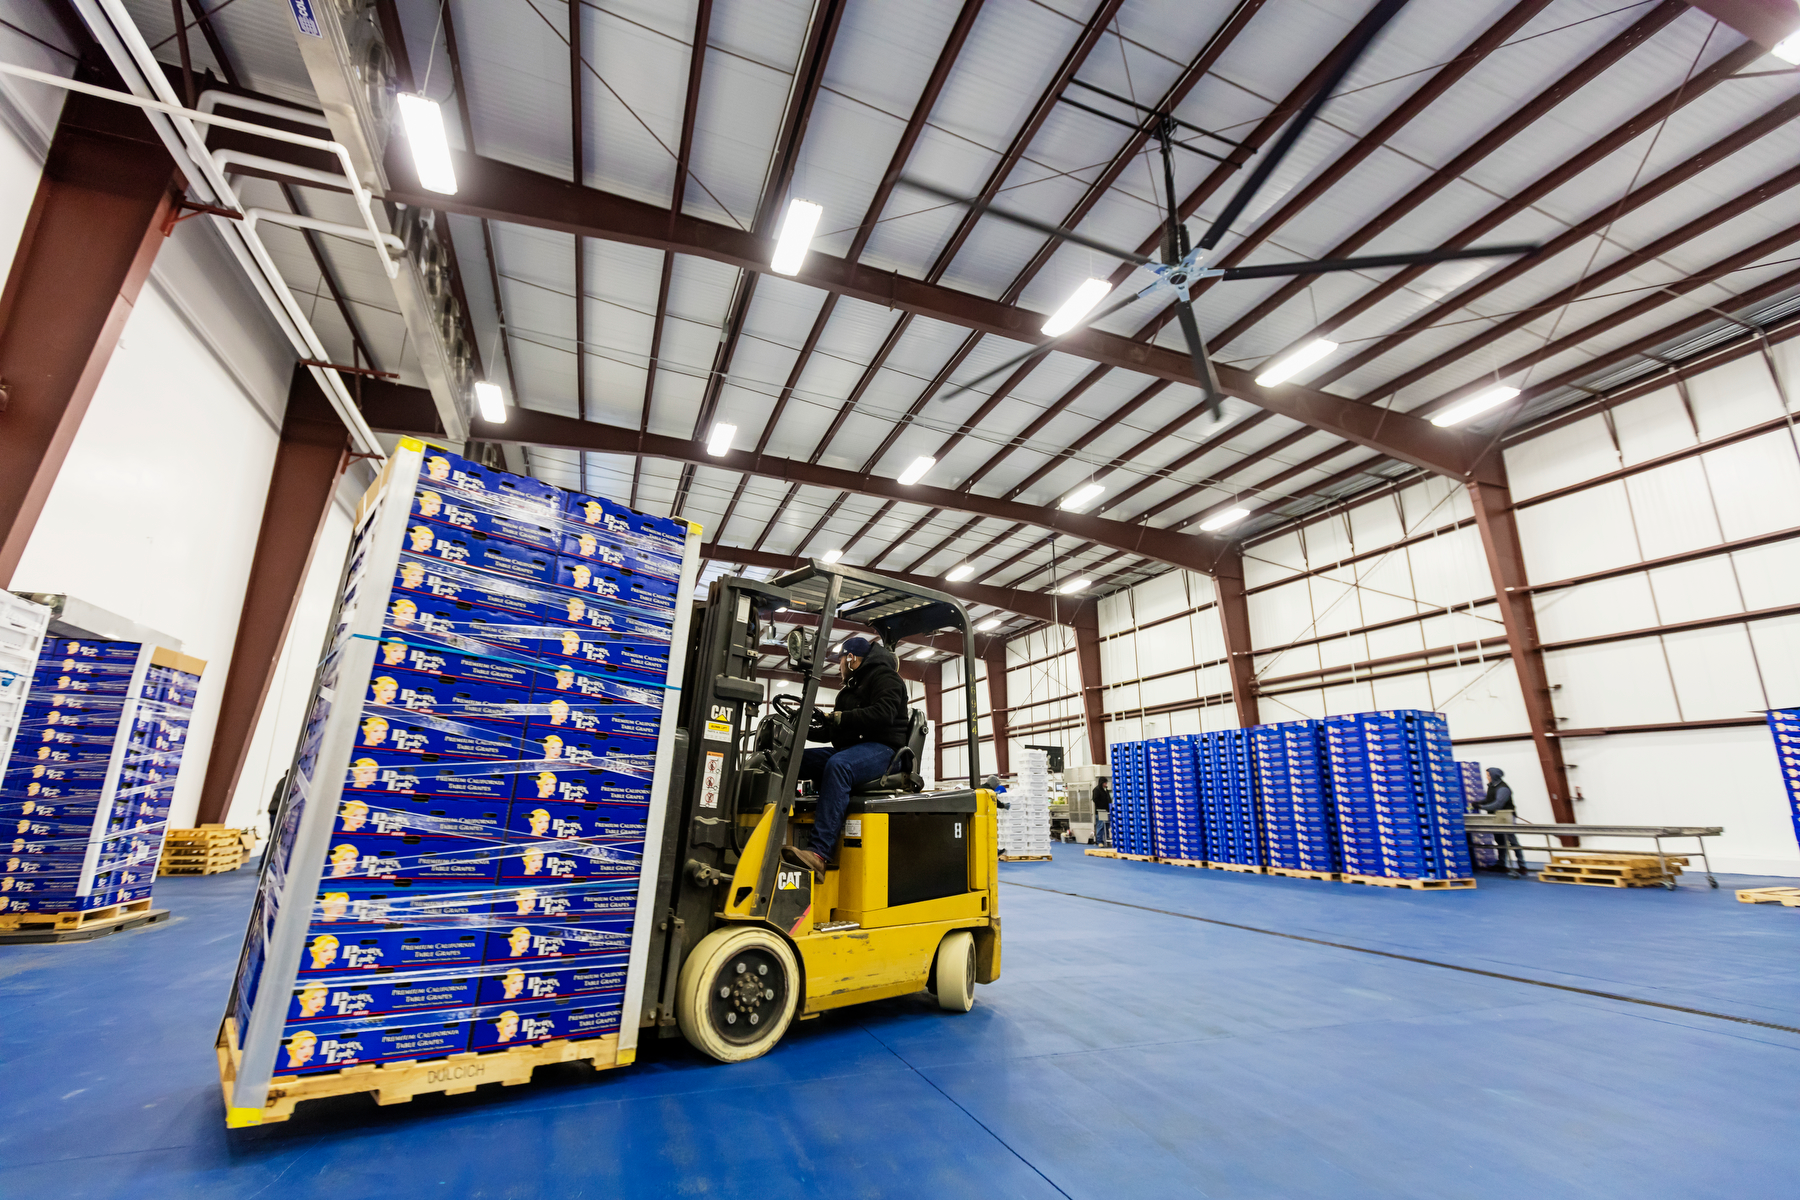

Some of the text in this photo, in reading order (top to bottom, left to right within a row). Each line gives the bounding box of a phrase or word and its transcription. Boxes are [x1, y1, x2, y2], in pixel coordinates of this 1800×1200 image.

[444, 504, 478, 523] Pretty
[449, 511, 472, 525] Lady
[604, 513, 630, 530] Pretty
[608, 521, 625, 532] Lady
[436, 539, 470, 557] Pretty
[441, 547, 464, 560] Lady
[599, 545, 625, 561] Pretty
[603, 552, 620, 564] Lady
[427, 575, 462, 592] Pretty
[432, 583, 455, 596] Lady
[593, 576, 620, 592] Pretty
[597, 584, 615, 595] Lady
[420, 612, 454, 629] Pretty
[588, 609, 615, 624] Pretty
[591, 617, 609, 627] Lady
[425, 621, 449, 634] Lady
[582, 642, 610, 656] Pretty
[586, 650, 605, 660] Lady
[410, 650, 446, 666] Pretty
[415, 659, 440, 670] Lady
[577, 676, 605, 690] Pretty
[581, 684, 600, 694] Lady
[400, 689, 437, 704] Pretty
[406, 698, 432, 710] Lady
[571, 710, 600, 724] Pretty
[711, 705, 733, 721] CAT
[576, 719, 595, 729] Lady
[391, 729, 429, 744] Pretty
[397, 738, 422, 750] Lady
[565, 746, 594, 758] Pretty
[570, 754, 588, 764] Lady
[382, 770, 420, 784] Pretty
[387, 780, 413, 791] Lady
[559, 782, 589, 794] Pretty
[563, 789, 583, 800] Lady
[371, 812, 410, 826] Pretty
[552, 819, 582, 831] Pretty
[377, 820, 404, 834] Lady
[557, 827, 577, 838] Lady
[361, 856, 401, 869] Pretty
[546, 857, 577, 868] Pretty
[367, 863, 394, 877] Lady
[551, 865, 572, 876] Lady
[778, 872, 801, 890] CAT
[539, 897, 571, 908] Pretty
[544, 904, 565, 915] Lady
[533, 936, 565, 948] Pretty
[342, 945, 384, 958] Pretty
[538, 944, 559, 956] Lady
[347, 954, 377, 968] Lady
[527, 976, 560, 989] Pretty
[532, 985, 554, 997] Lady
[331, 992, 374, 1006] Pretty
[337, 1001, 366, 1015] Lady
[521, 1019, 555, 1032] Pretty
[526, 1027, 549, 1040] Lady
[319, 1040, 363, 1055] Pretty
[326, 1050, 356, 1064] Lady
[427, 1064, 485, 1084] DULCICH
